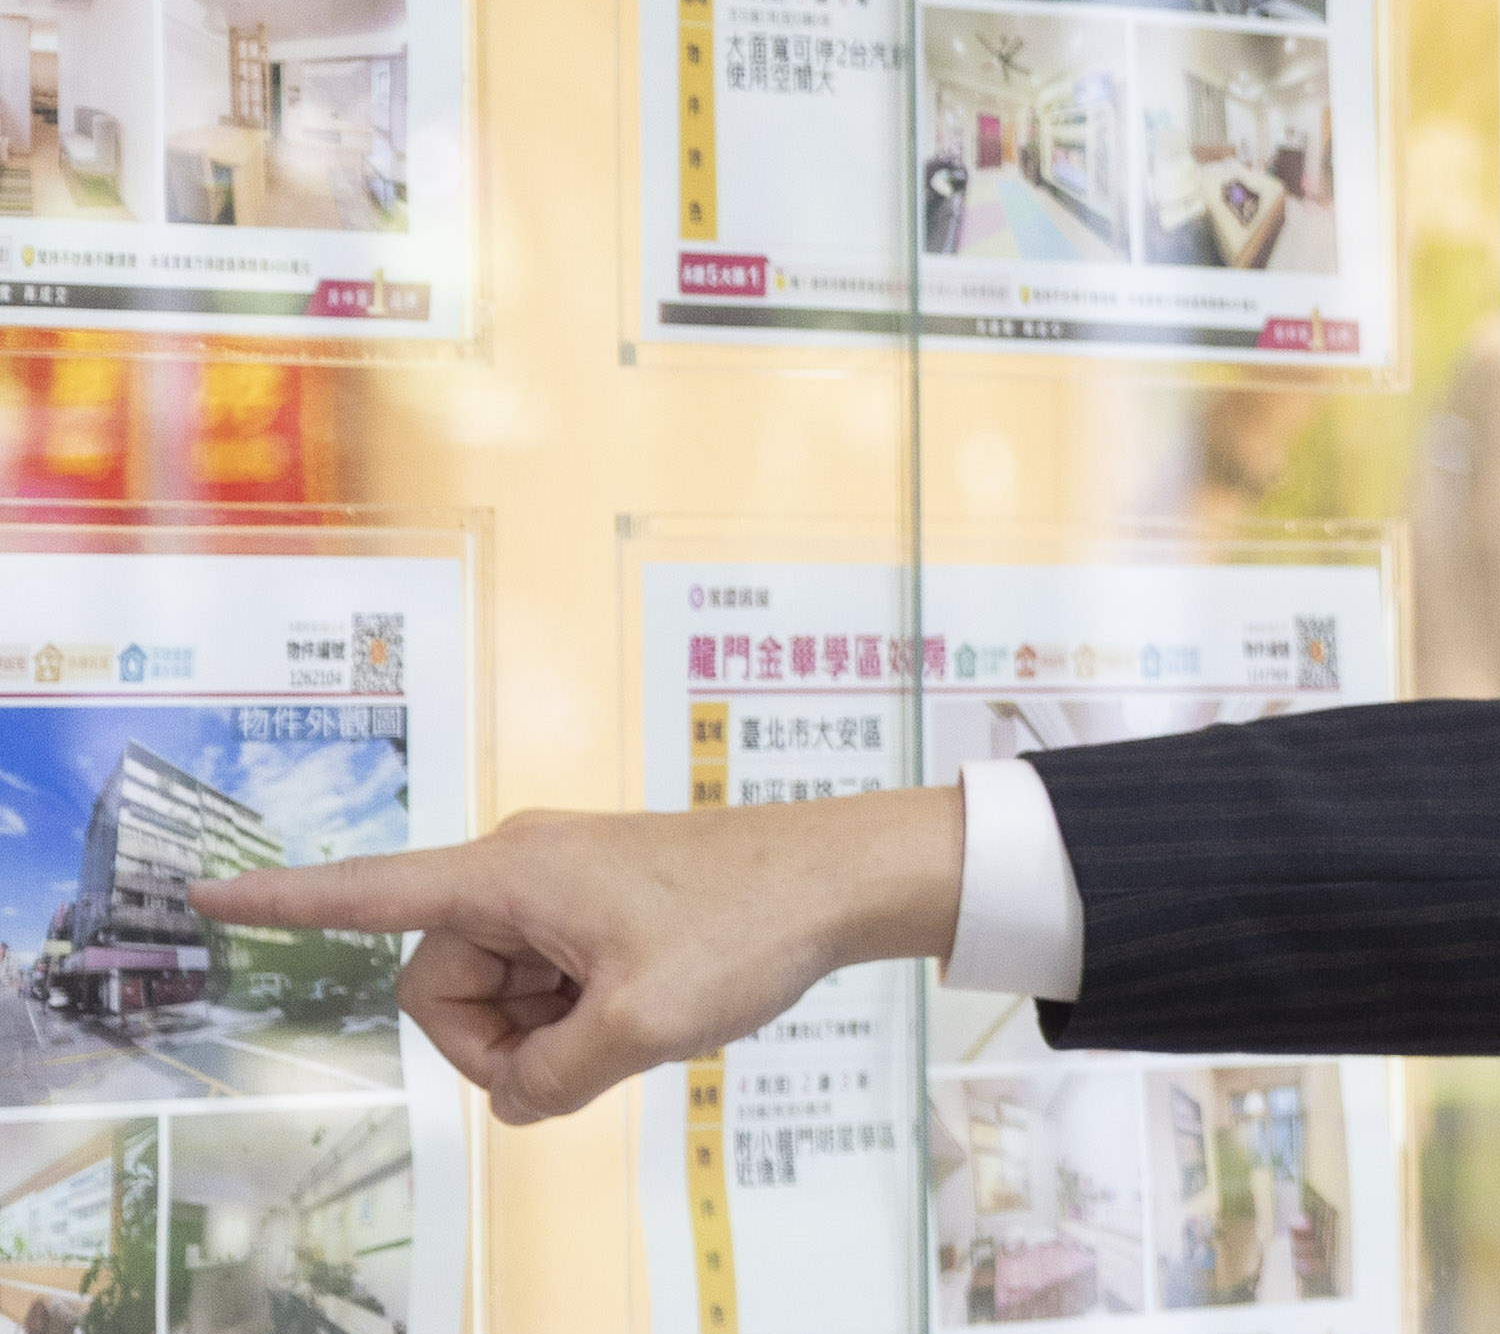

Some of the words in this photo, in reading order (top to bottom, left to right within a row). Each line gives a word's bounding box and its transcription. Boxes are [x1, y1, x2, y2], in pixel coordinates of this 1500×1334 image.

[237, 705, 404, 740] 物件外觀圖
[740, 715, 883, 753] 臺北市大安區
